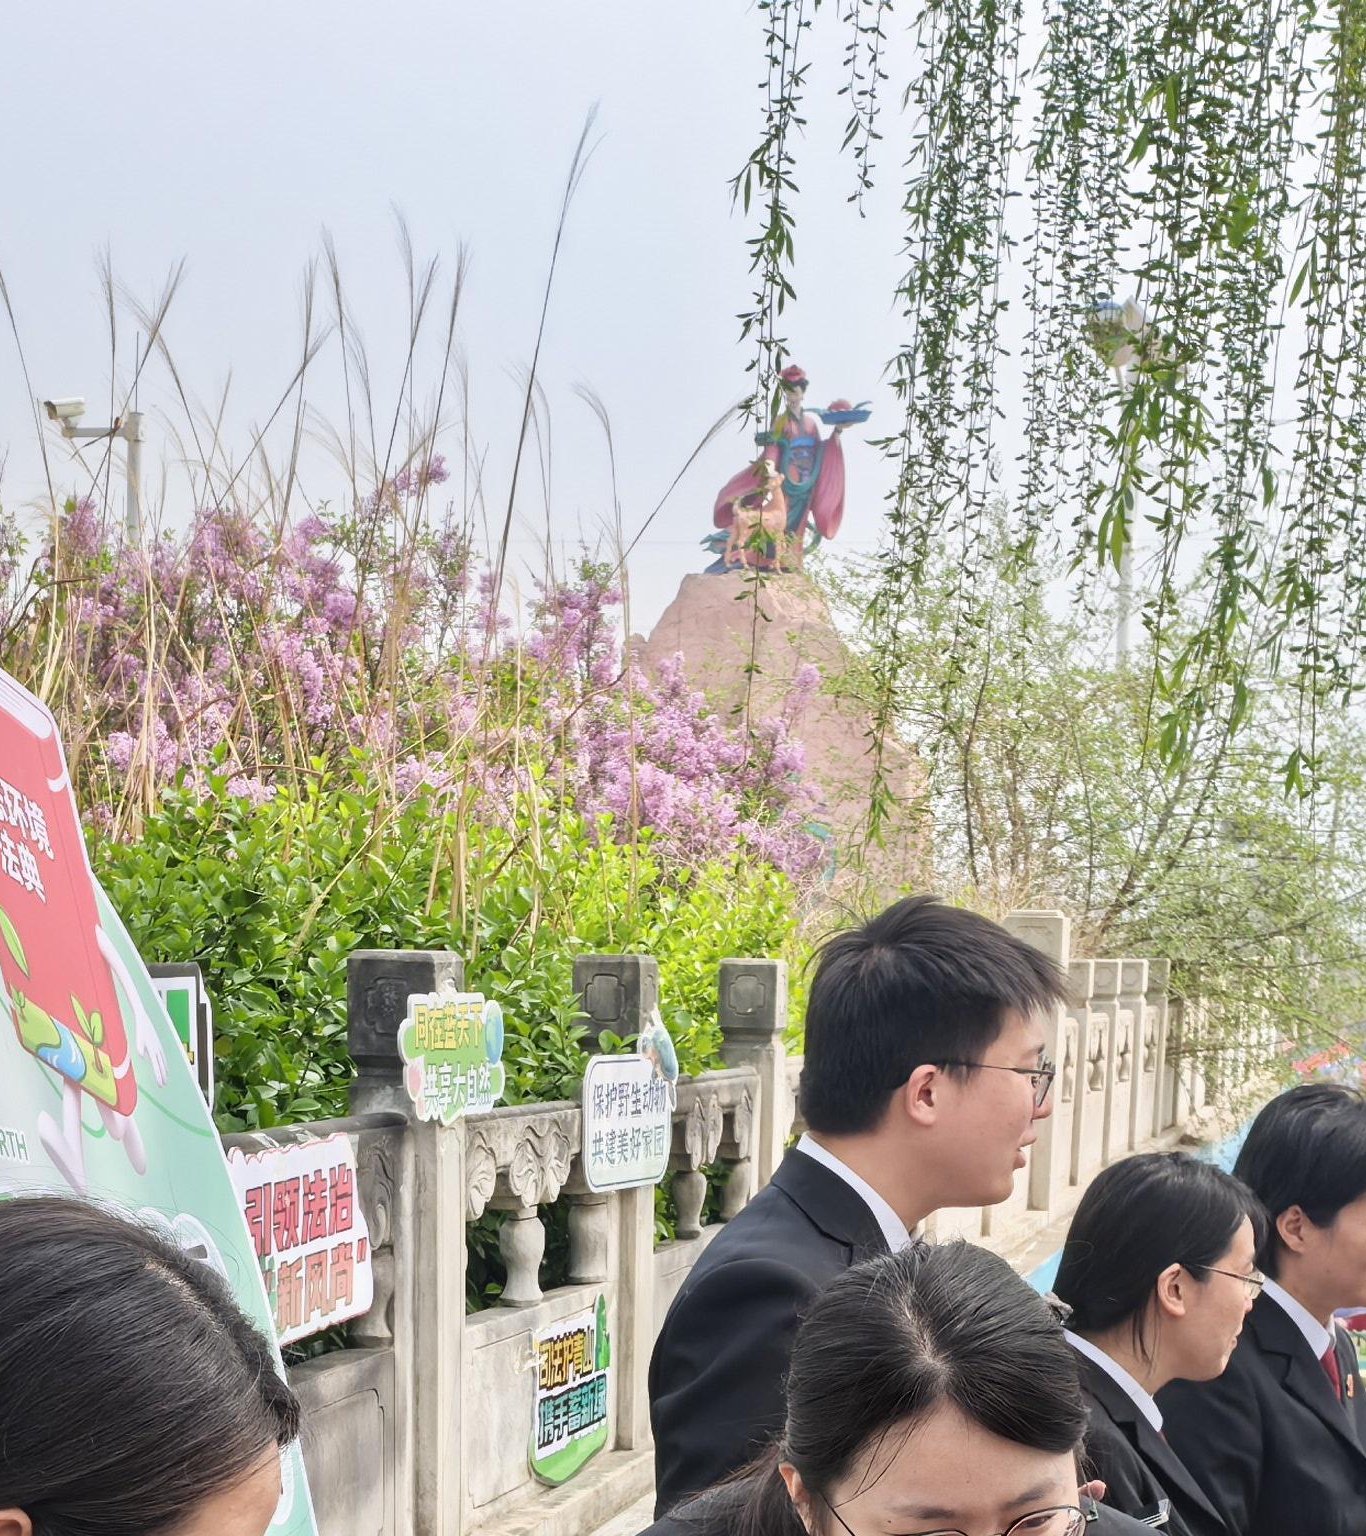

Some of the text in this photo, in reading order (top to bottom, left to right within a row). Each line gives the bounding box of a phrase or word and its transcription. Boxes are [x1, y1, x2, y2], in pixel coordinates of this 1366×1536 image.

[424, 1059, 491, 1111] 共享大自然
[593, 1079, 667, 1120] 保护野生动物
[538, 1325, 595, 1391] 司法护青山
